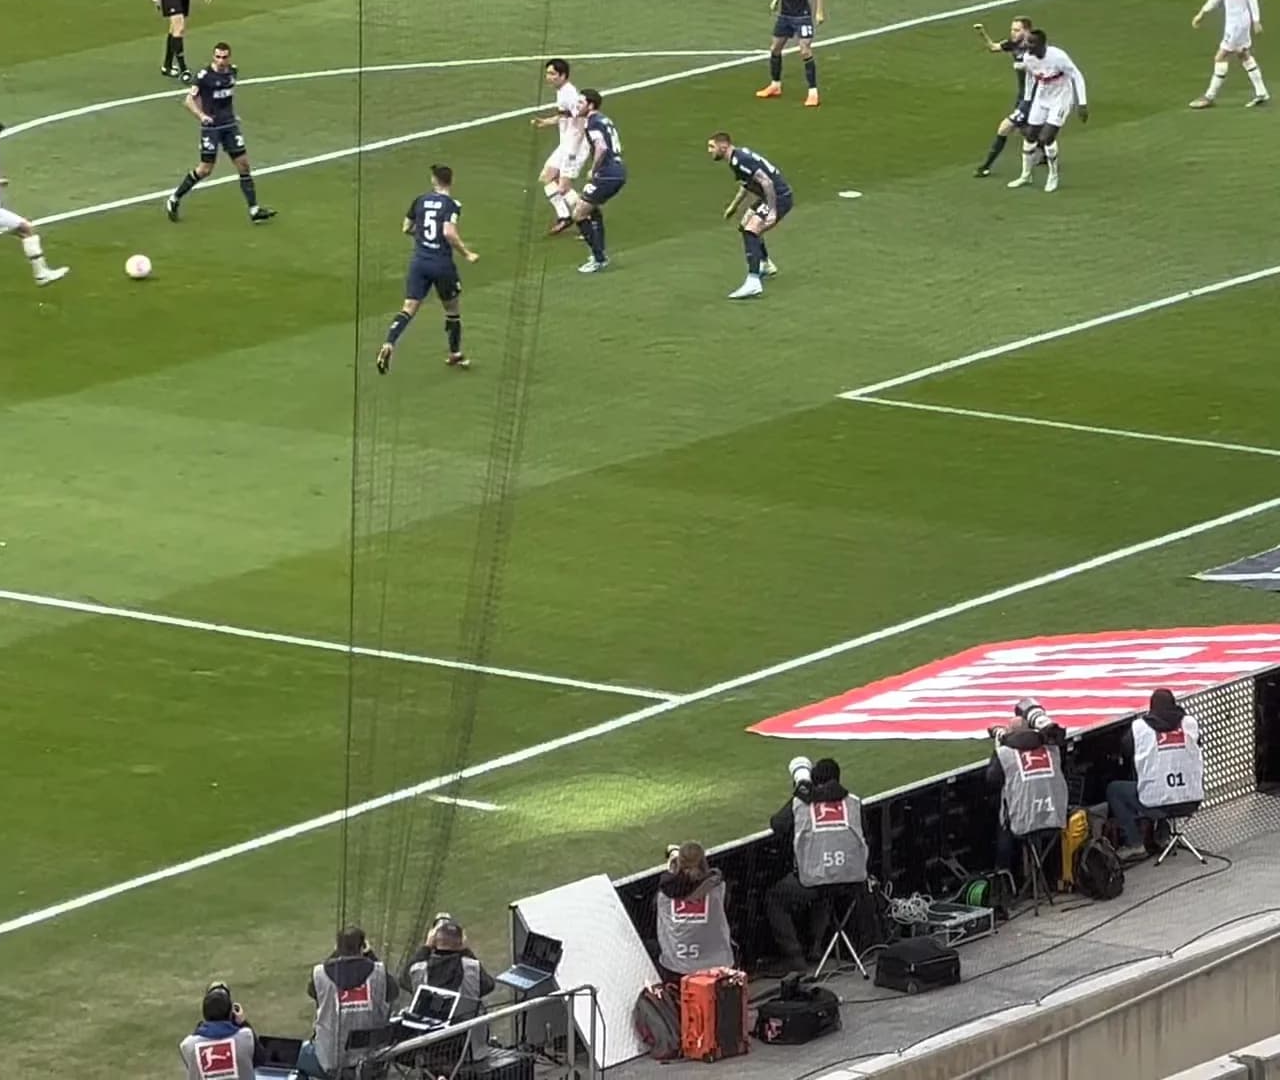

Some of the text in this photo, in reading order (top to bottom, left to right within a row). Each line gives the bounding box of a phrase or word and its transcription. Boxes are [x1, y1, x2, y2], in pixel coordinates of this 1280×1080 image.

[423, 211, 437, 241] 5
[1166, 772, 1186, 787] 01
[823, 850, 845, 867] 58
